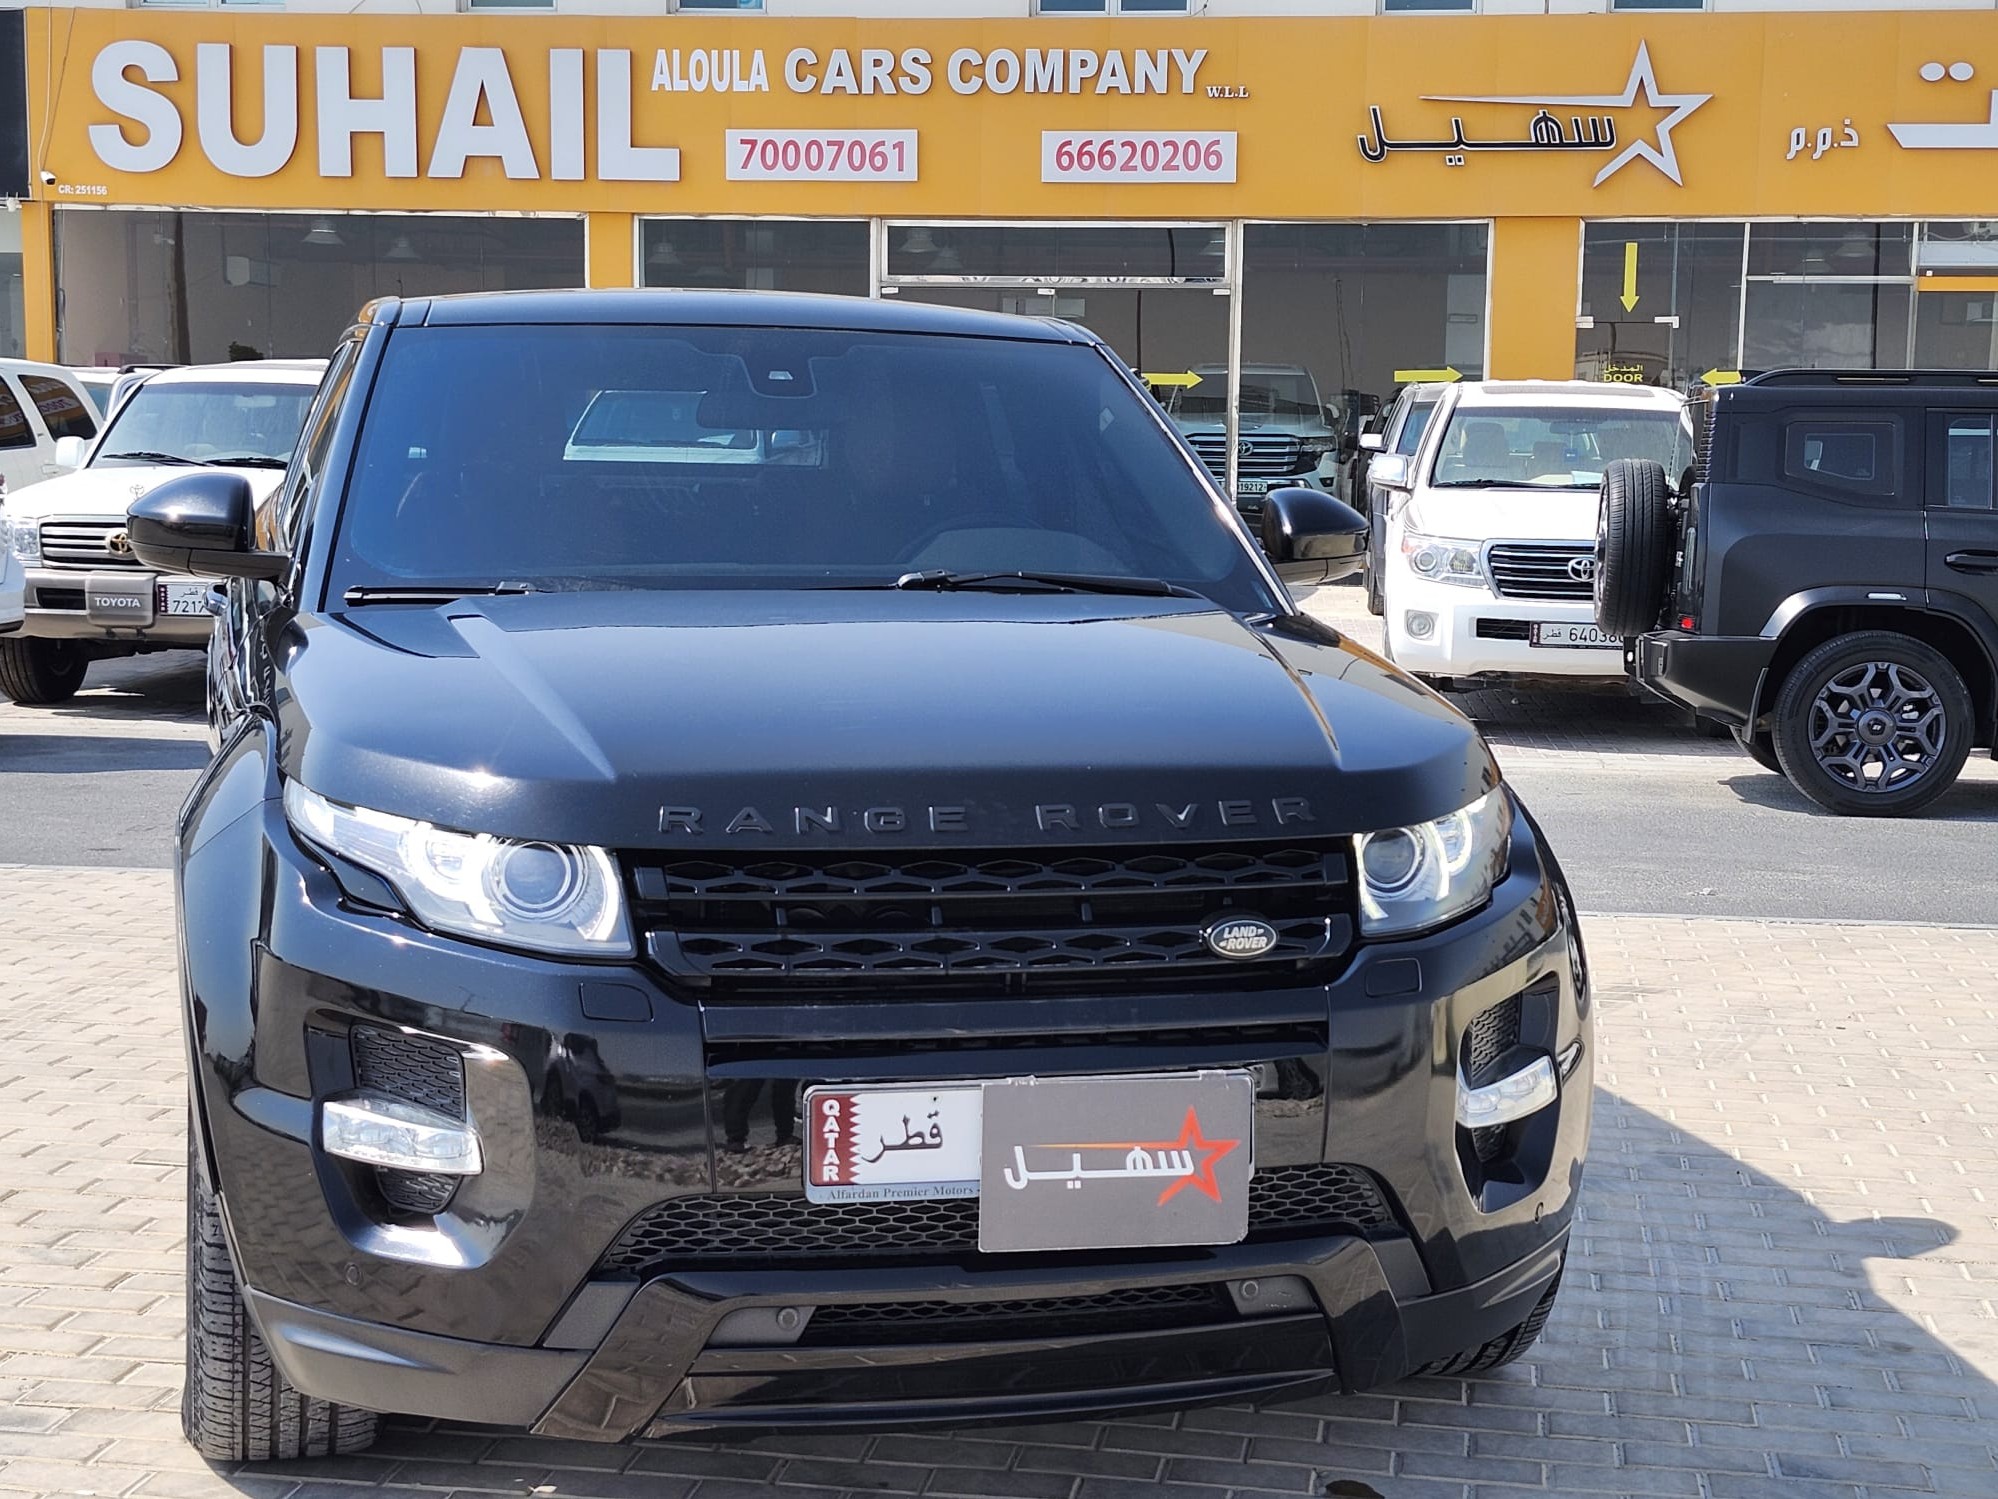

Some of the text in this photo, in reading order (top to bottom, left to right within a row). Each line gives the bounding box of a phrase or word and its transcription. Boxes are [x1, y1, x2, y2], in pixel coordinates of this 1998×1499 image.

[651, 49, 769, 92] ALOULA
[784, 47, 932, 94] CARS
[947, 47, 1208, 95] COMPANY
[88, 39, 681, 181] SUHAIL
[1357, 105, 1617, 166] سهيل
[739, 138, 905, 172] 70007061
[1055, 138, 1223, 172] 66620206
[1603, 373, 1643, 382] DOOR
[1237, 483, 1264, 491] 19212
[95, 597, 141, 608] TOYOTA
[658, 797, 1317, 833] RANGE ROVER
[1223, 926, 1258, 938] LAND
[1226, 936, 1267, 950] ROVER
[821, 1099, 841, 1182] QATAR
[1004, 1145, 1195, 1190] سهيل
[827, 1185, 974, 1201] Alfardan Premier Motors
